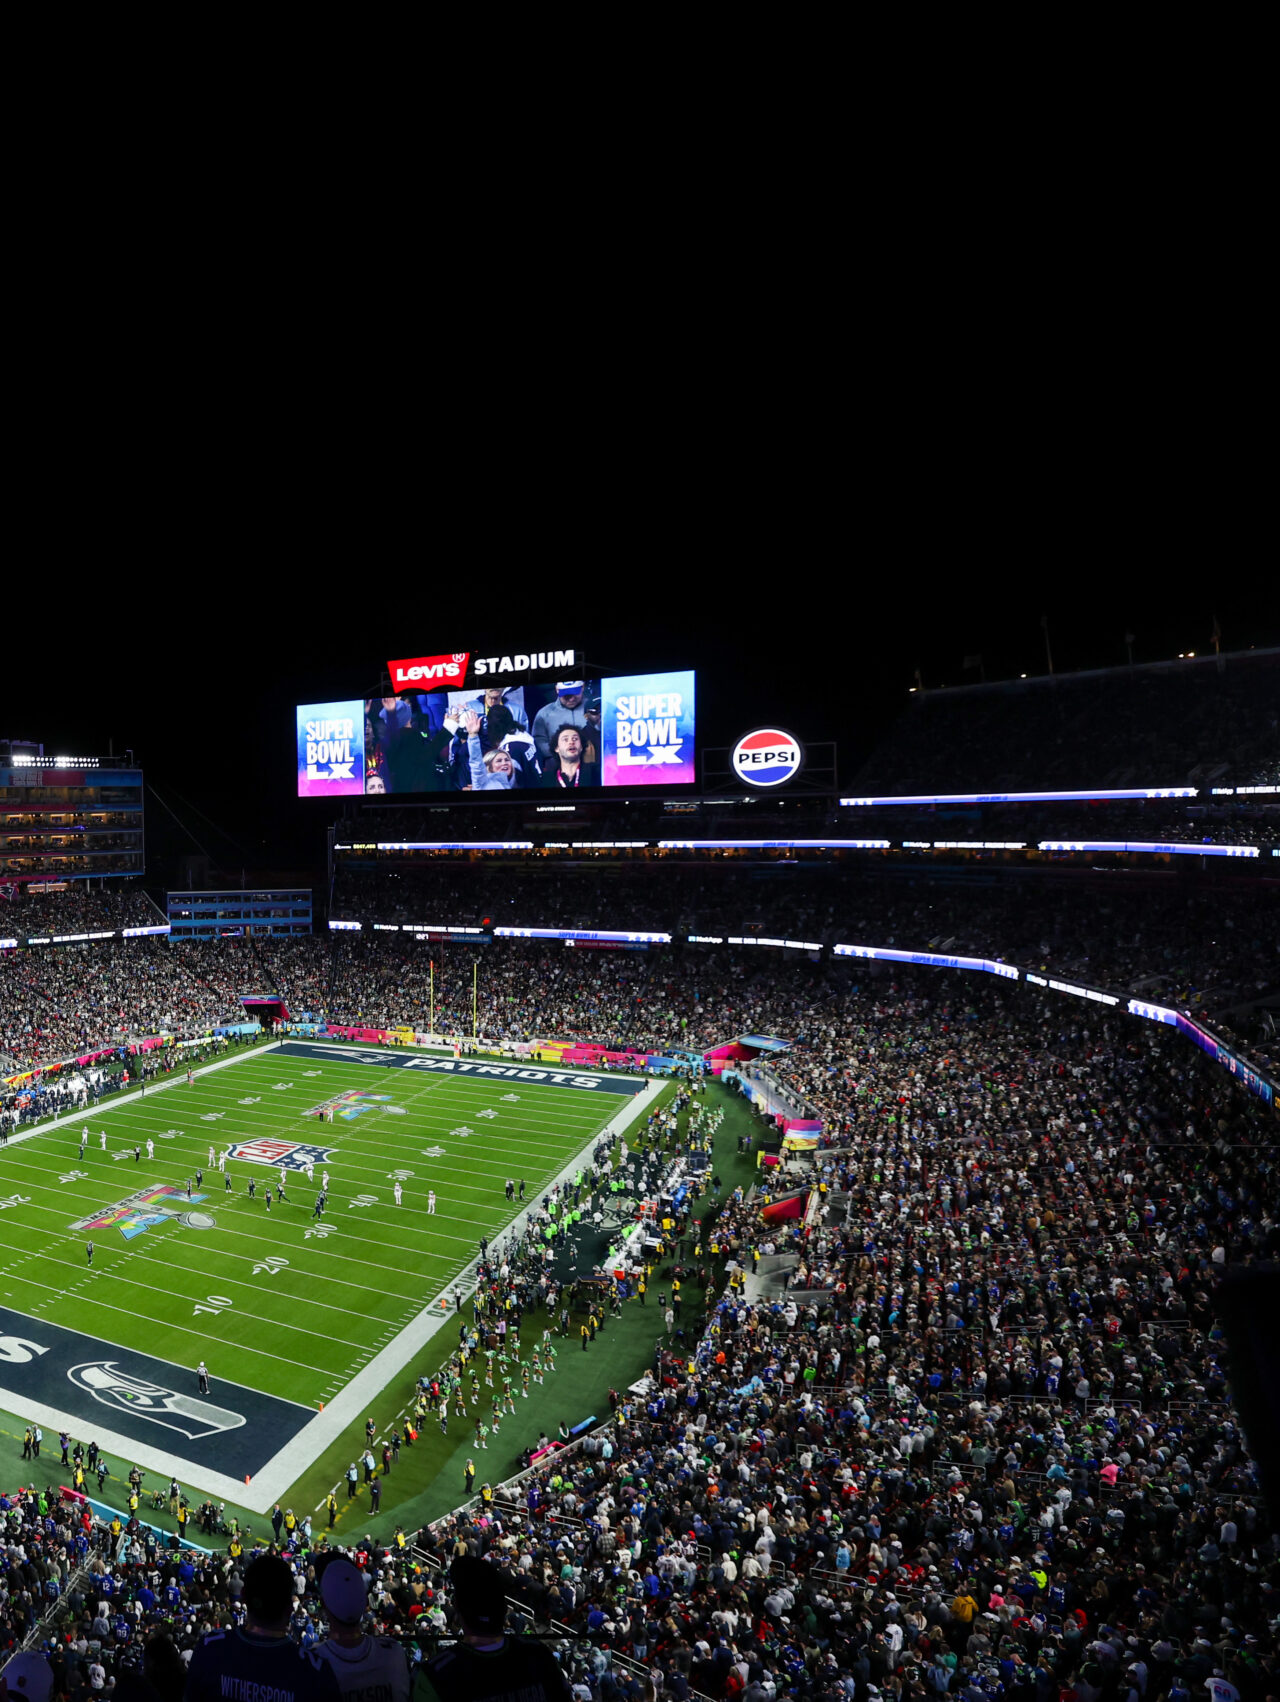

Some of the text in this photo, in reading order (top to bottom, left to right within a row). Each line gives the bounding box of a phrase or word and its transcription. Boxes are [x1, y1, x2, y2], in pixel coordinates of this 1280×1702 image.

[474, 650, 574, 675] STADIUM
[616, 693, 682, 720] SUPER
[306, 719, 353, 741] SUPER
[616, 718, 683, 747] BOWL
[306, 739, 354, 764] BOWL
[617, 745, 683, 766] LX
[739, 752, 794, 764] PEPSI
[307, 763, 355, 780] LX
[402, 1058, 602, 1088] PATRIOTS
[237, 1141, 297, 1160] NFL
[58, 1170, 88, 1184] 30
[81, 1188, 154, 1223] SUPER BOWL
[350, 1194, 379, 1208] 40
[305, 1223, 337, 1238] 30
[253, 1256, 289, 1275] 20
[194, 1295, 232, 1315] 10
